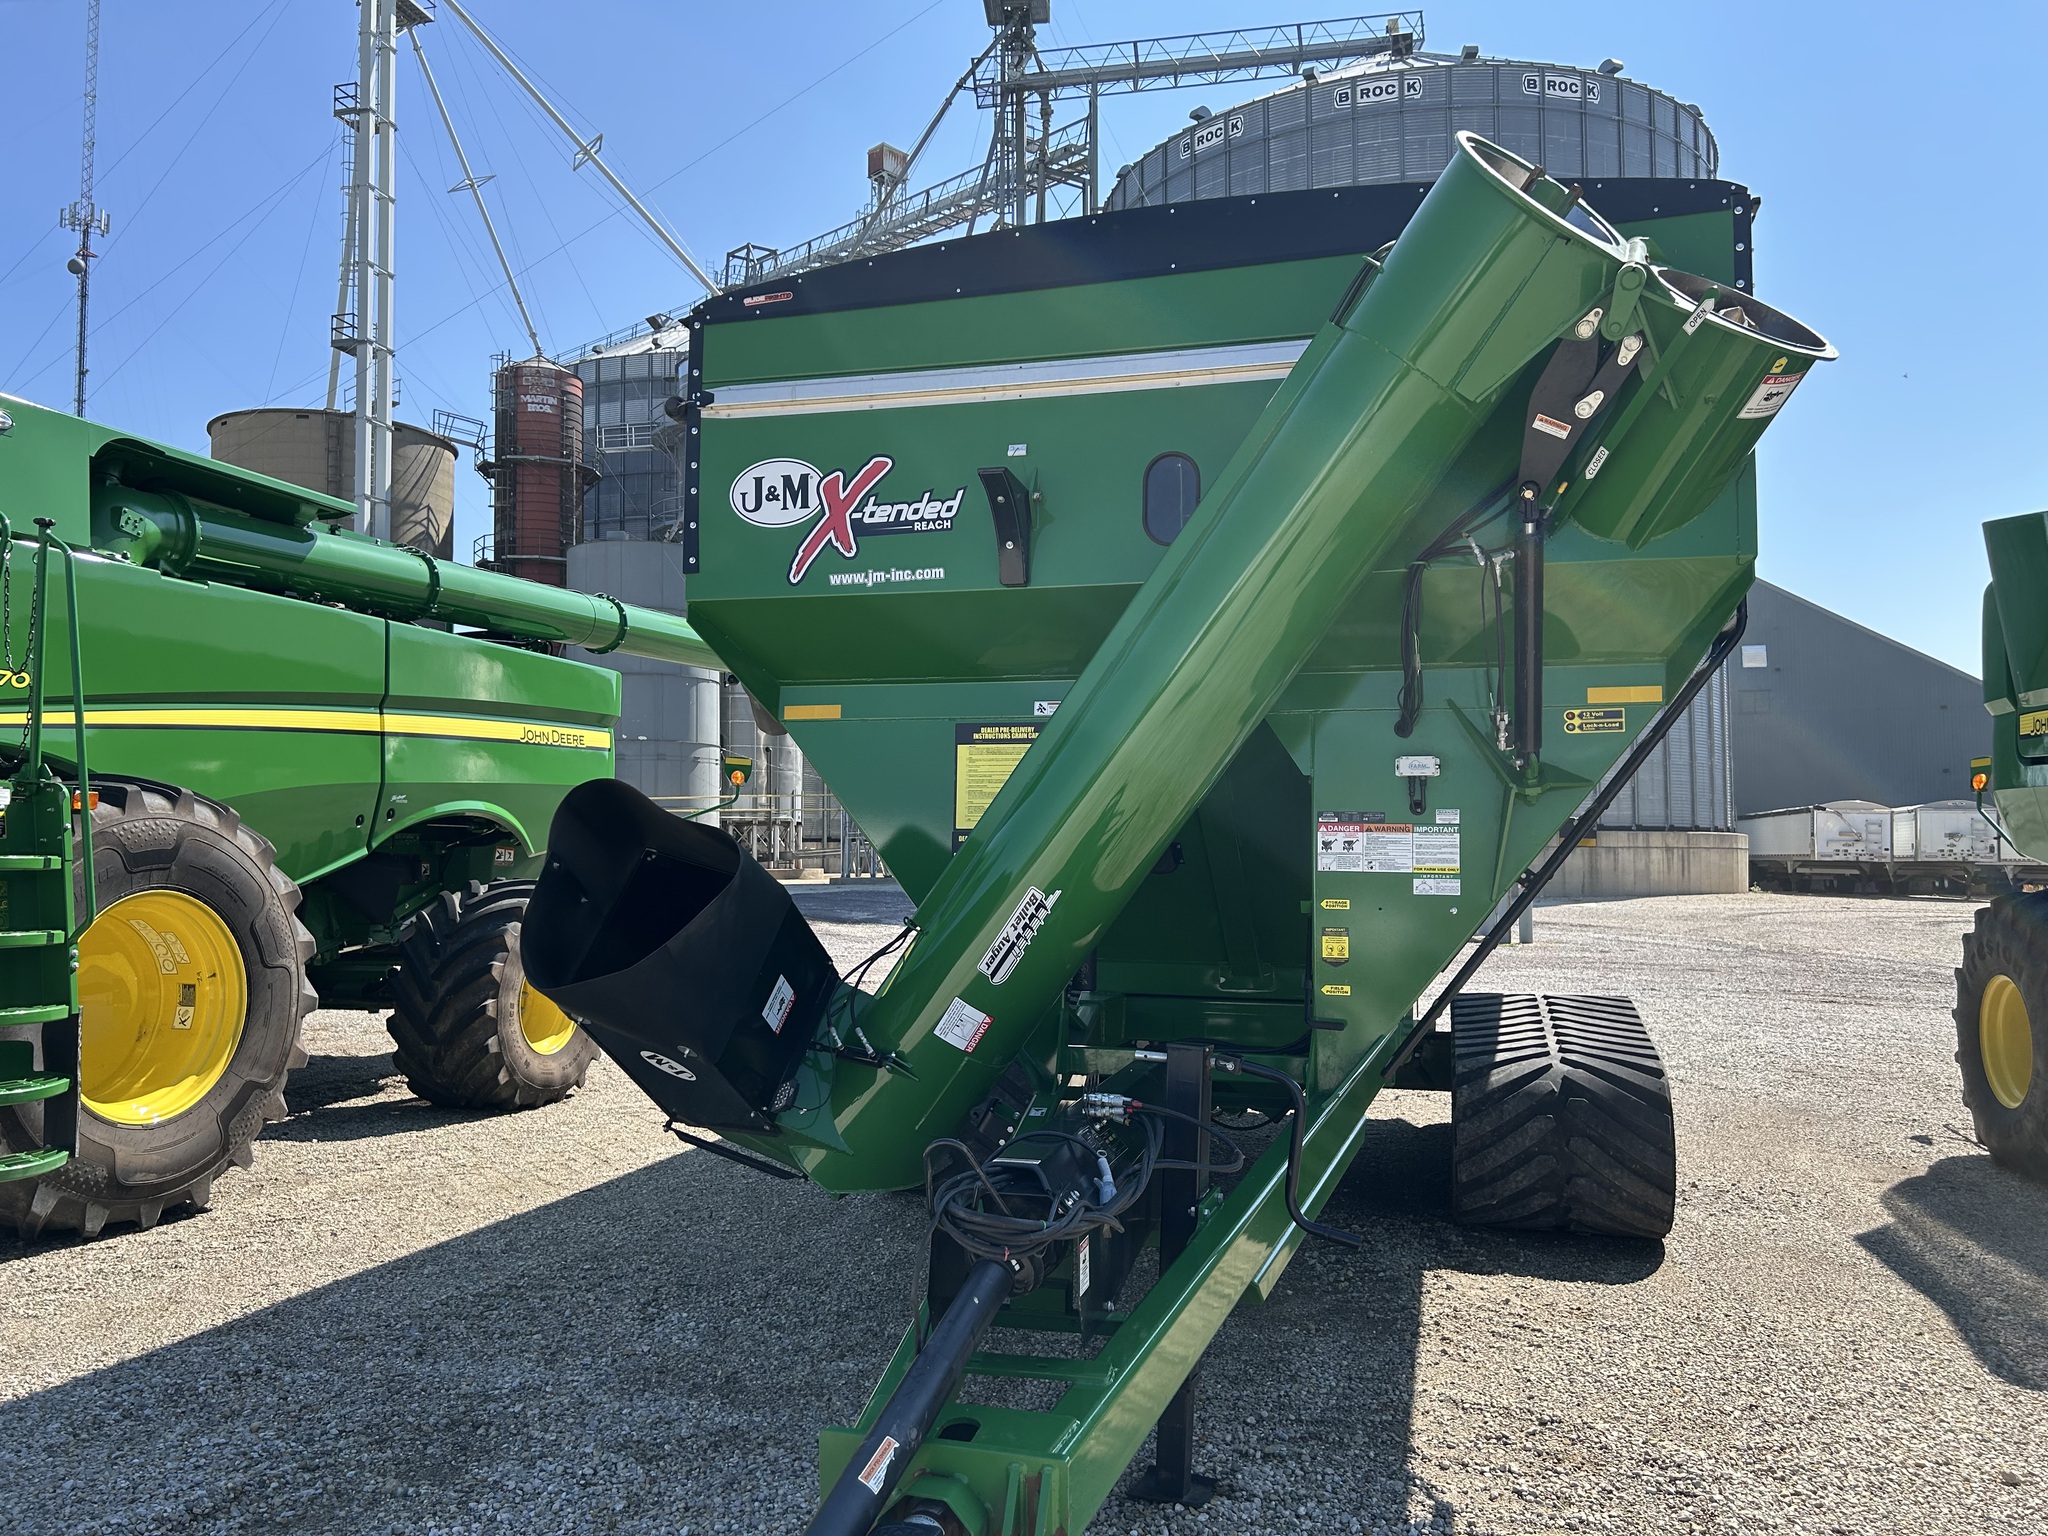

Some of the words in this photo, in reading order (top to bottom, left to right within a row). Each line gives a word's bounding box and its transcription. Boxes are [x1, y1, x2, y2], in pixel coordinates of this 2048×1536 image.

[1336, 79, 1420, 106] BROCK
[1525, 77, 1598, 100] BROCK
[1181, 117, 1242, 156] BROCK
[1689, 308, 1707, 328] OPEN
[520, 394, 558, 405] MARTIN
[527, 404, 553, 413] BROS.
[1588, 449, 1606, 475] CLOSED
[740, 473, 811, 513] J&M
[914, 519, 951, 531] REACH
[829, 567, 944, 587] www.jm-inc.com
[520, 727, 550, 743] JOHN
[552, 730, 585, 746] DEERE
[973, 732, 1011, 740] INSTRUCTIONS
[2030, 714, 2048, 735] JOH
[1011, 893, 1038, 932] Bullet
[985, 931, 1011, 971] Auger
[775, 1001, 794, 1035] DANGER
[966, 1022, 989, 1053] DANGER
[645, 1053, 694, 1081] J&M
[864, 1464, 875, 1480] CHECK
[879, 1441, 892, 1459] OVERLAP
